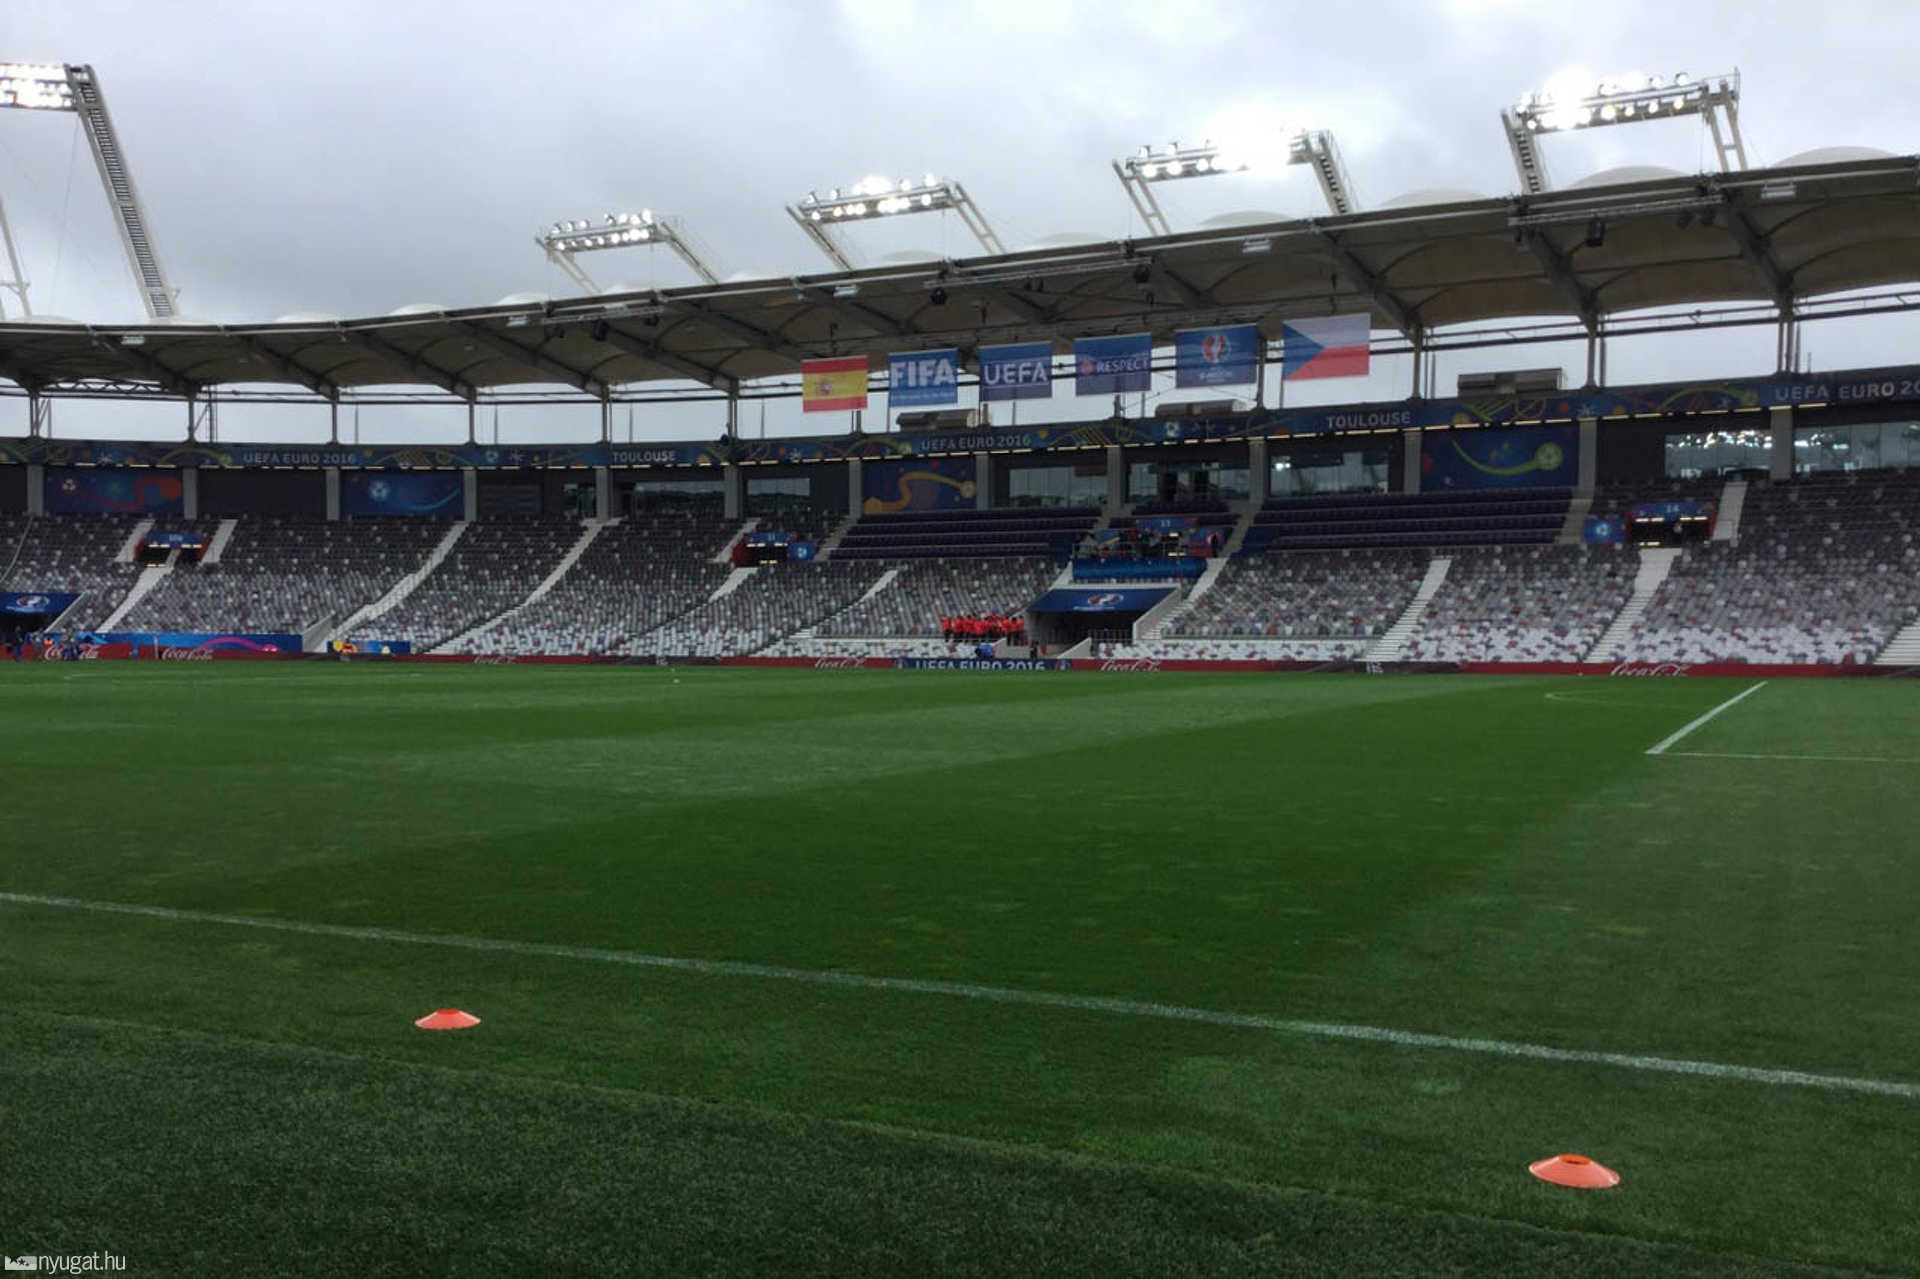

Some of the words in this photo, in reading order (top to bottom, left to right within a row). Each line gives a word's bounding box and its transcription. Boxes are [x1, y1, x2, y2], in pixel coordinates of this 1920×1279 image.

[890, 358, 955, 387] FIFA
[984, 362, 1048, 385] UEFA
[1097, 359, 1148, 373] RESPECT
[1776, 385, 1829, 401] UEFA
[1839, 382, 1895, 399] EURO
[1327, 411, 1410, 428] TOULOUSE
[921, 436, 956, 450] UEFA
[959, 436, 994, 449] EURO
[998, 434, 1031, 447] 2016
[243, 453, 280, 464] UEFA
[283, 453, 320, 464] EURO
[323, 453, 356, 464] 2016
[613, 450, 676, 462] TOULOUSE
[959, 661, 1002, 670] EURO
[1006, 661, 1046, 670] 2016
